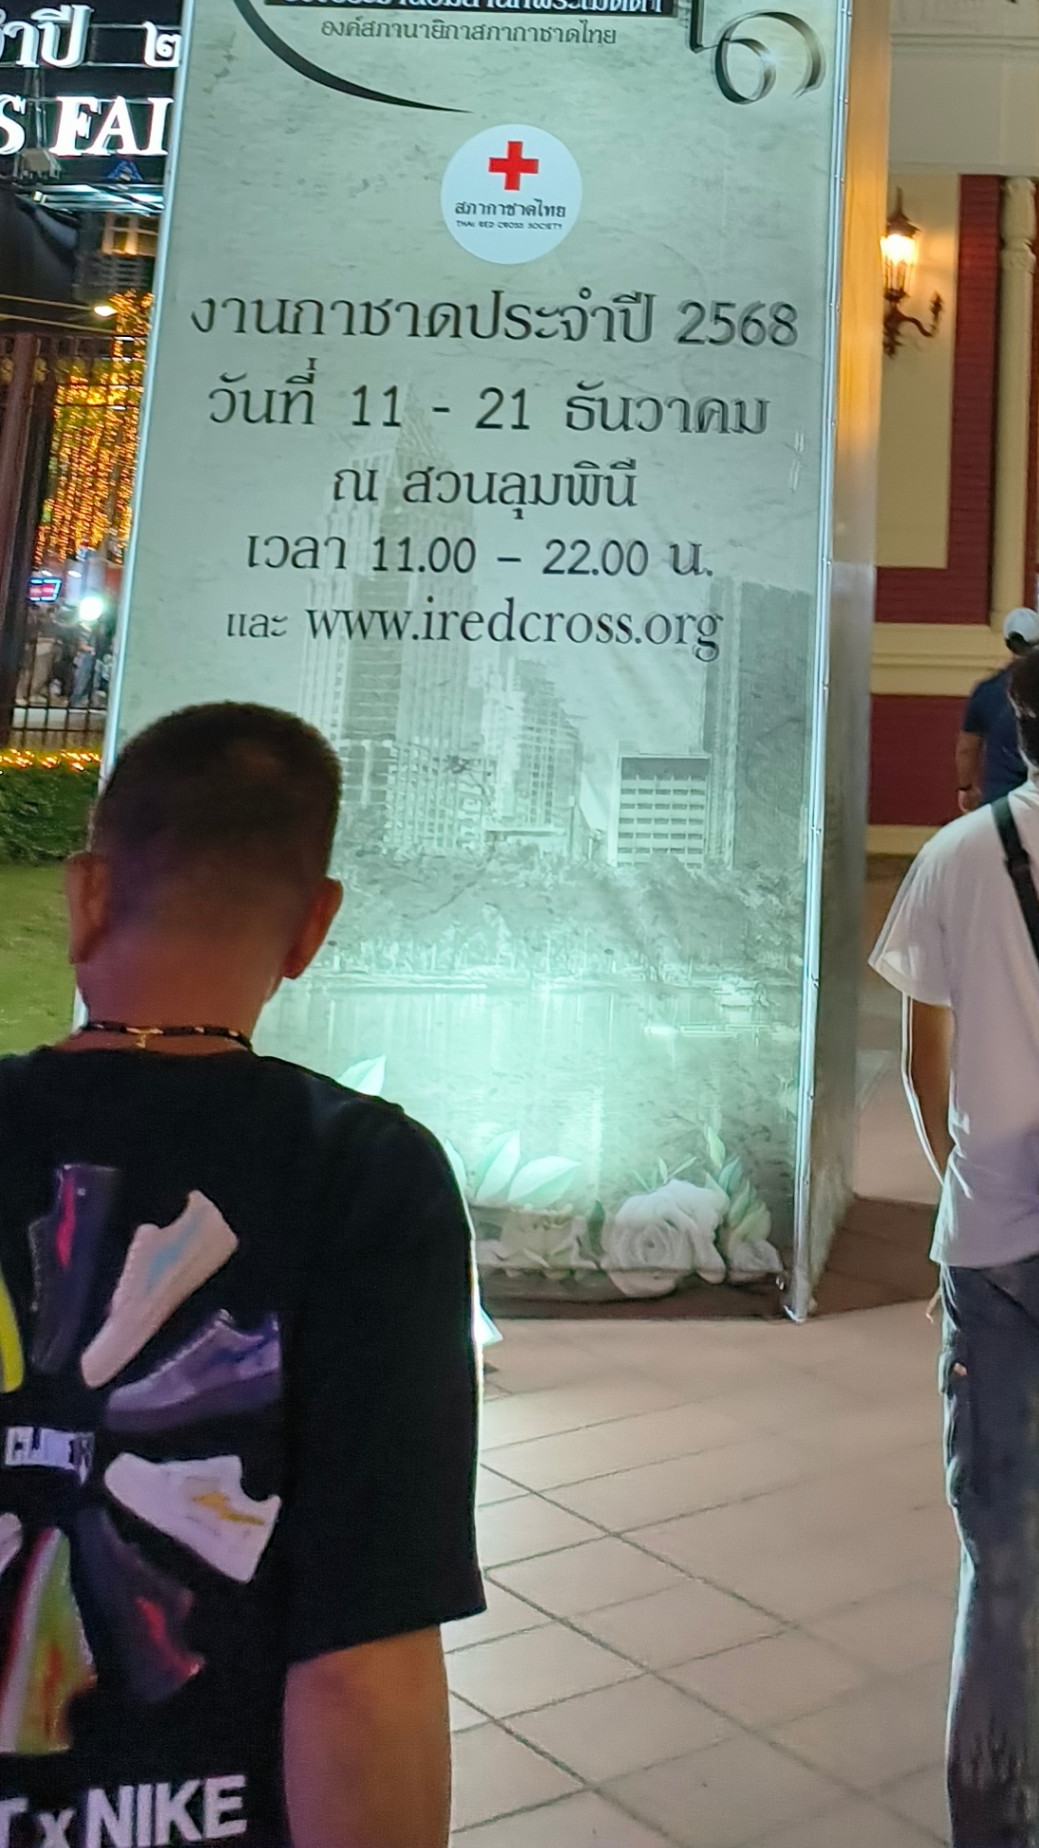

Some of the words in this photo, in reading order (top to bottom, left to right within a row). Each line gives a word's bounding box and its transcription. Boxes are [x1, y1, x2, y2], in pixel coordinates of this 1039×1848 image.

[0, 4, 94, 69] ำปี
[454, 197, 567, 218] สภากาชาดไทย
[190, 286, 657, 344] งานกาชาดประจำปี
[676, 300, 799, 348] 2568
[208, 357, 317, 425] วันที่
[350, 383, 402, 429] 11
[474, 386, 532, 432] 21
[564, 380, 770, 436] ธันวาคม
[332, 467, 379, 502] ณ
[401, 457, 639, 521] สวนลุมพินี
[246, 533, 347, 571] เวลา
[372, 535, 477, 574] 11.00
[541, 538, 650, 578] 22.00
[668, 541, 715, 579] น.
[226, 611, 289, 640] และ
[304, 595, 725, 664] www.iredcross.org
[85, 1774, 249, 1848] NIKE
